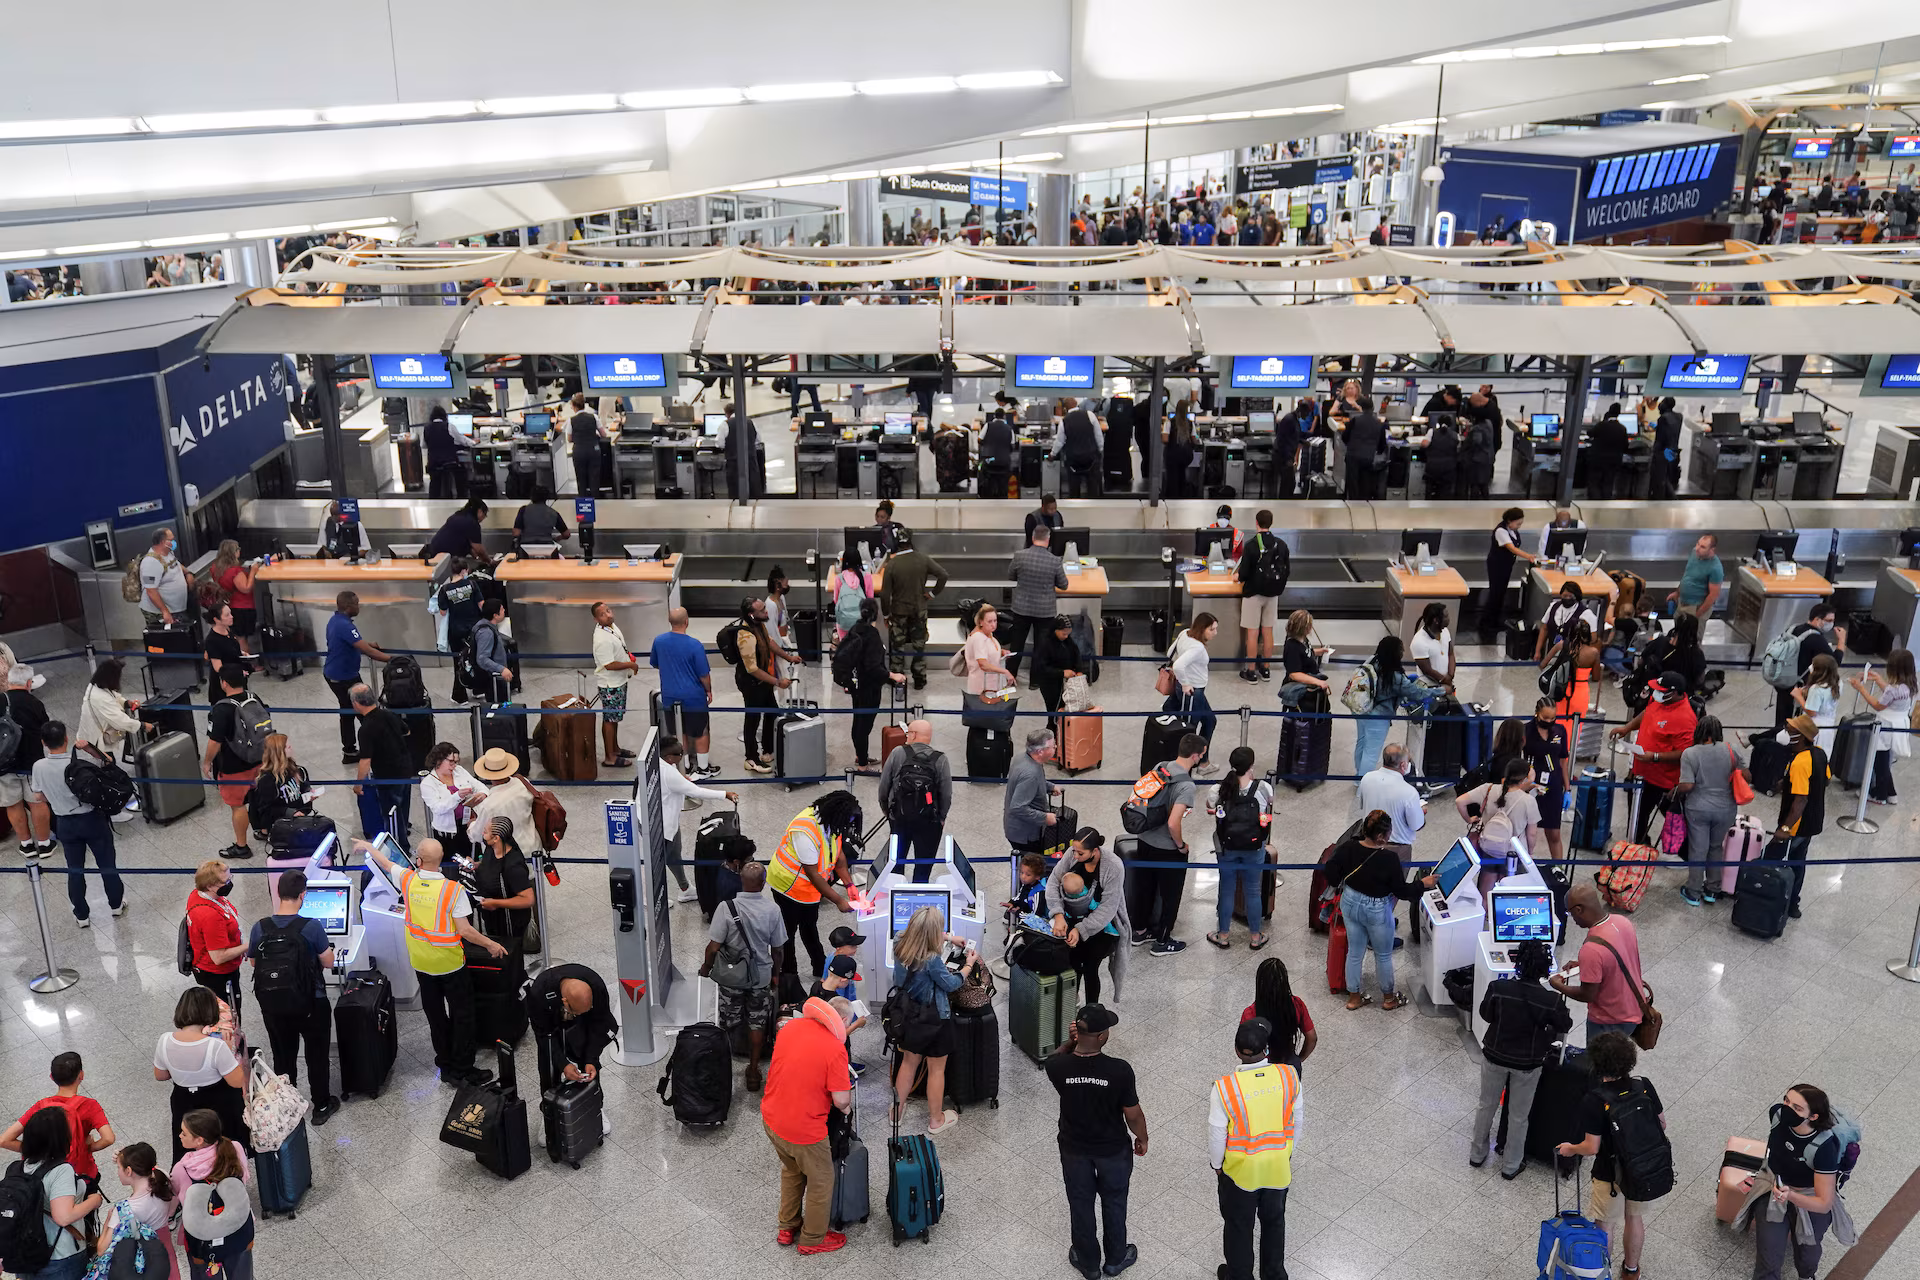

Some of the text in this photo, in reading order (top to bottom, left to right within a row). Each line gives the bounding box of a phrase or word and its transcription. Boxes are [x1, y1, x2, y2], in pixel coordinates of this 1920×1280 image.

[911, 178, 969, 194] South Checkpoint
[1586, 188, 1700, 228] WELCOME ABOARD
[380, 375, 447, 383] SELF-TAGGED BAG DROP
[1669, 375, 1708, 383] SELF-TAGGED
[199, 375, 267, 438] DELTA
[351, 628, 359, 639] 5
[416, 893, 436, 903] DELTA
[303, 901, 328, 909] CHECK
[1505, 907, 1539, 916] CHECK IN
[1065, 1076, 1109, 1087] #DELTAPROUD
[1253, 1085, 1282, 1097] DELTA
